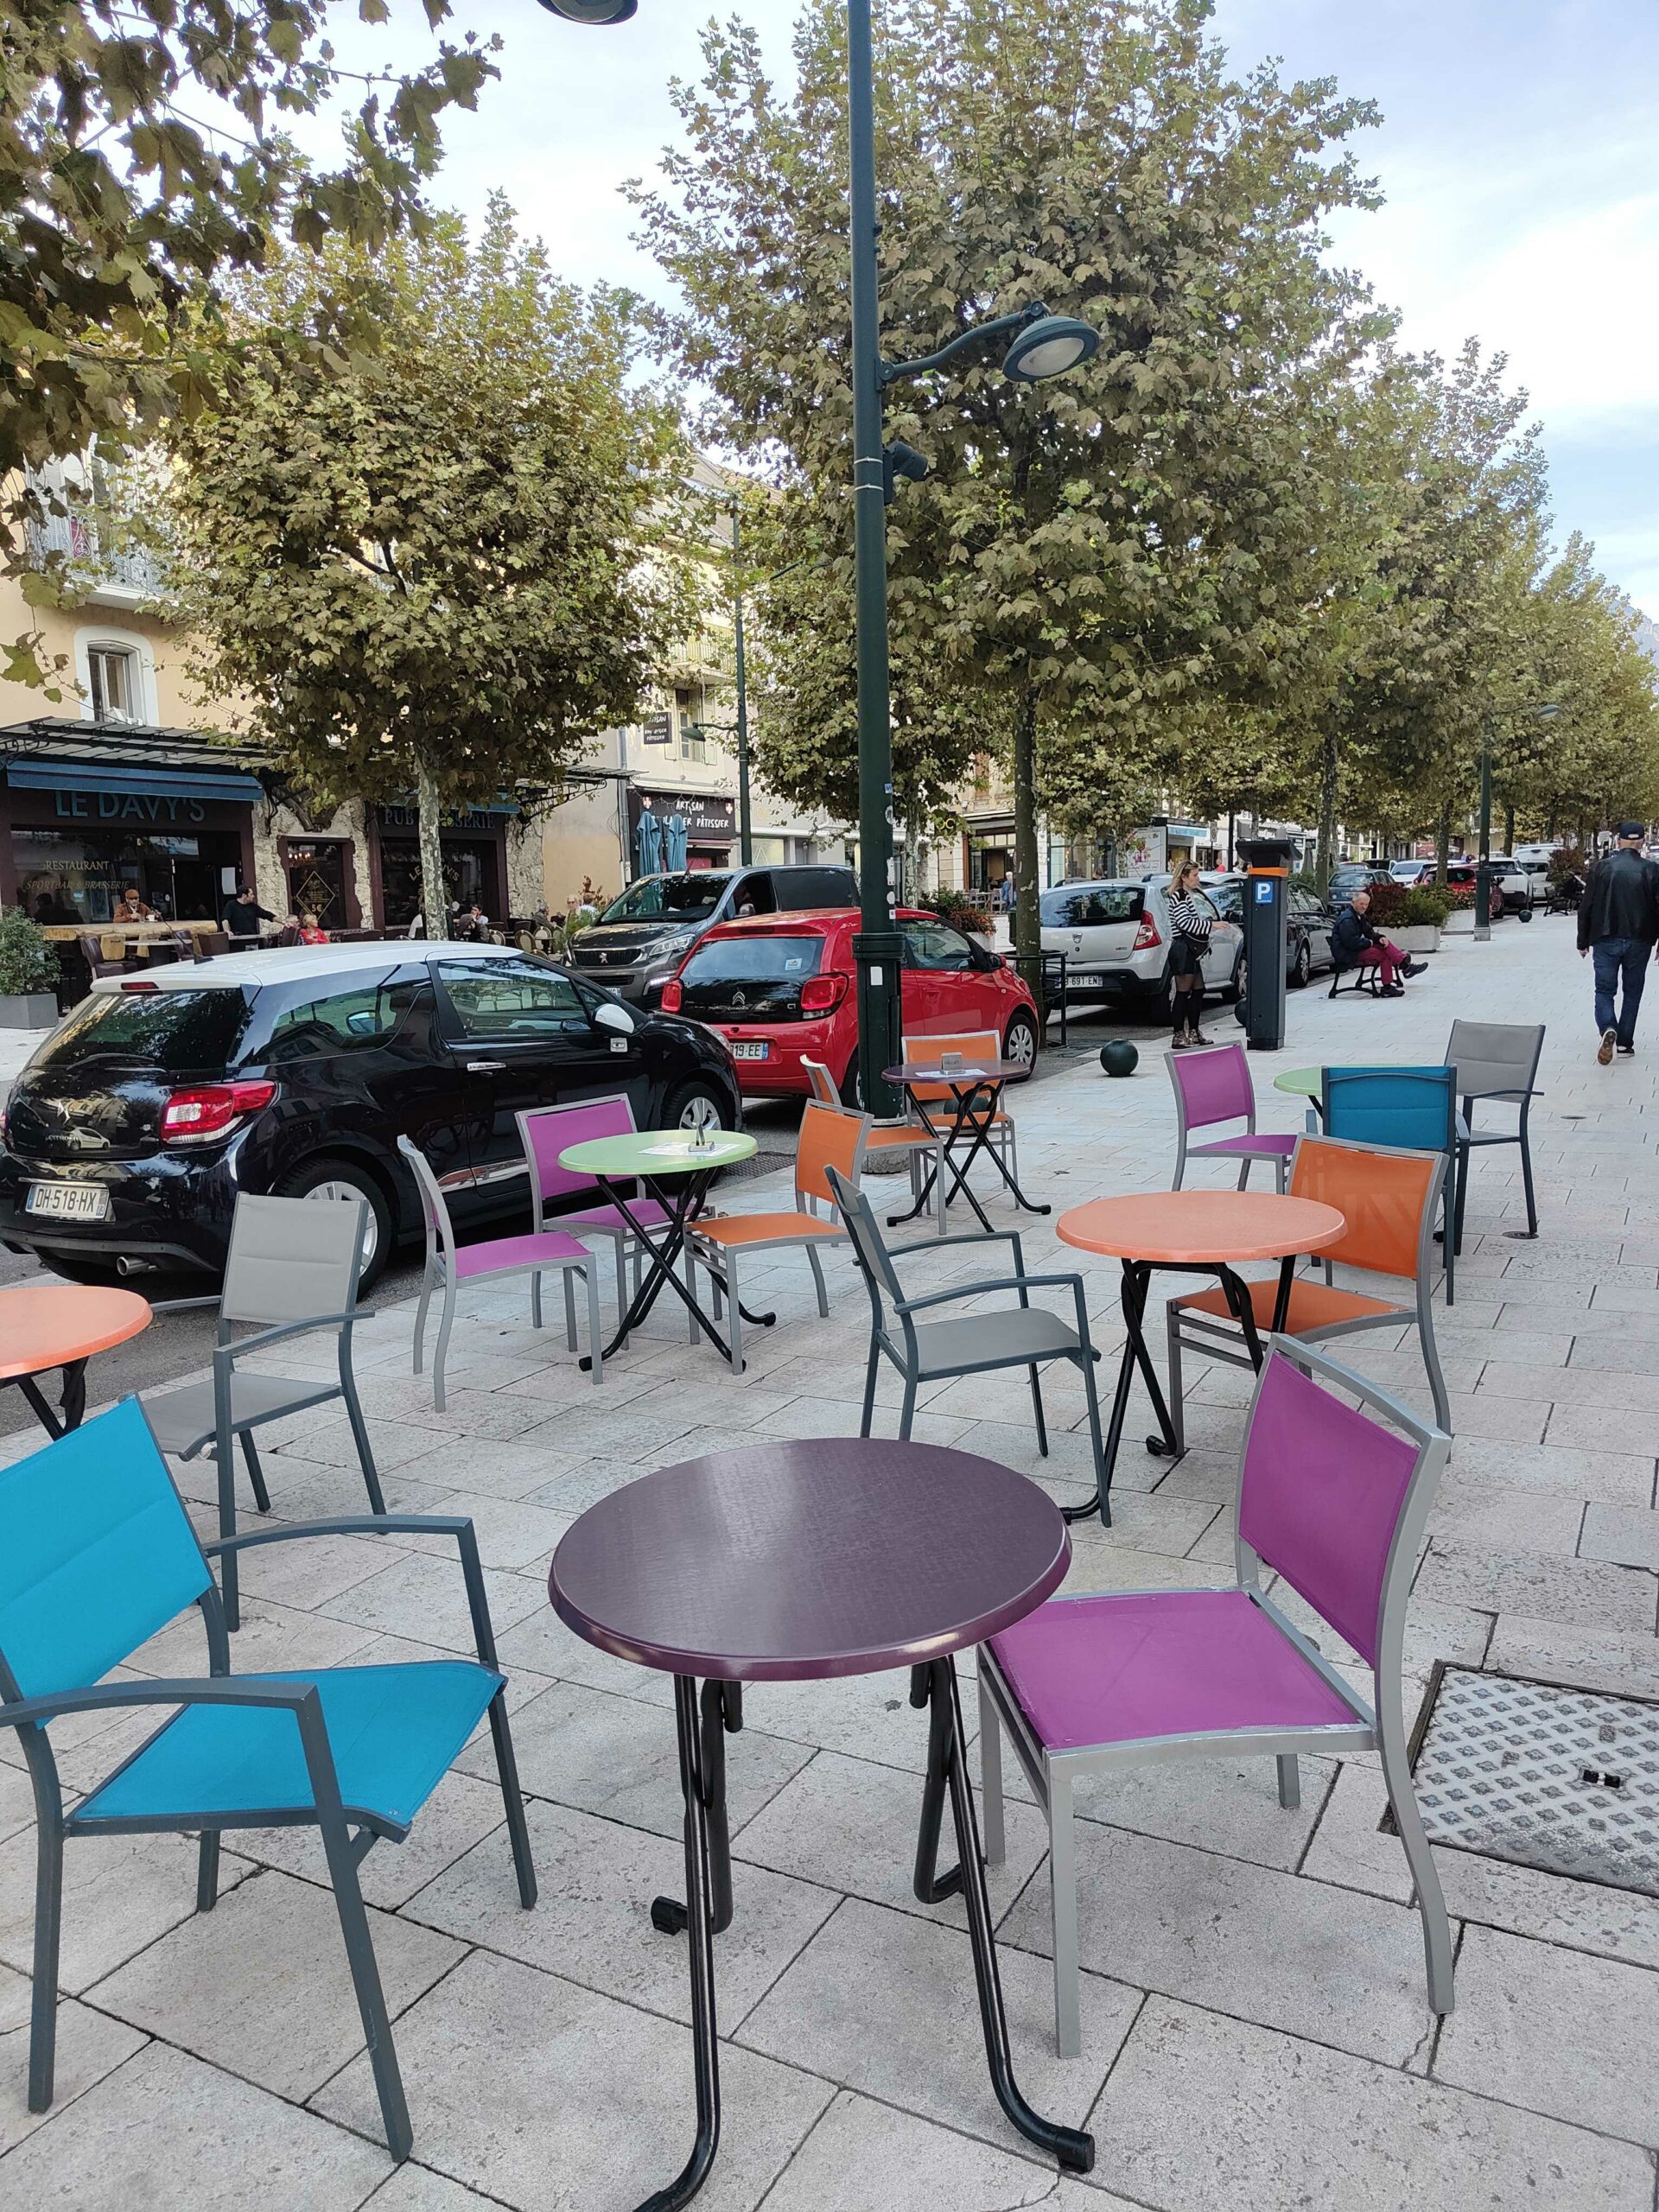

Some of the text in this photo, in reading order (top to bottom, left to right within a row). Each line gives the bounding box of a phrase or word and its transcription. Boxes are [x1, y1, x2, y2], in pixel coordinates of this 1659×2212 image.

[55, 790, 206, 822] LE DAVY'S
[676, 800, 704, 814] ARTISAN
[384, 808, 414, 825] PUB
[696, 815, 729, 828] PÂTISSIER
[45, 861, 110, 871] RESTAURANT
[409, 866, 423, 881] LE
[84, 880, 130, 890] BRASSERIE
[1257, 882, 1271, 900] P
[35, 1188, 97, 1212] DH-518-HX
